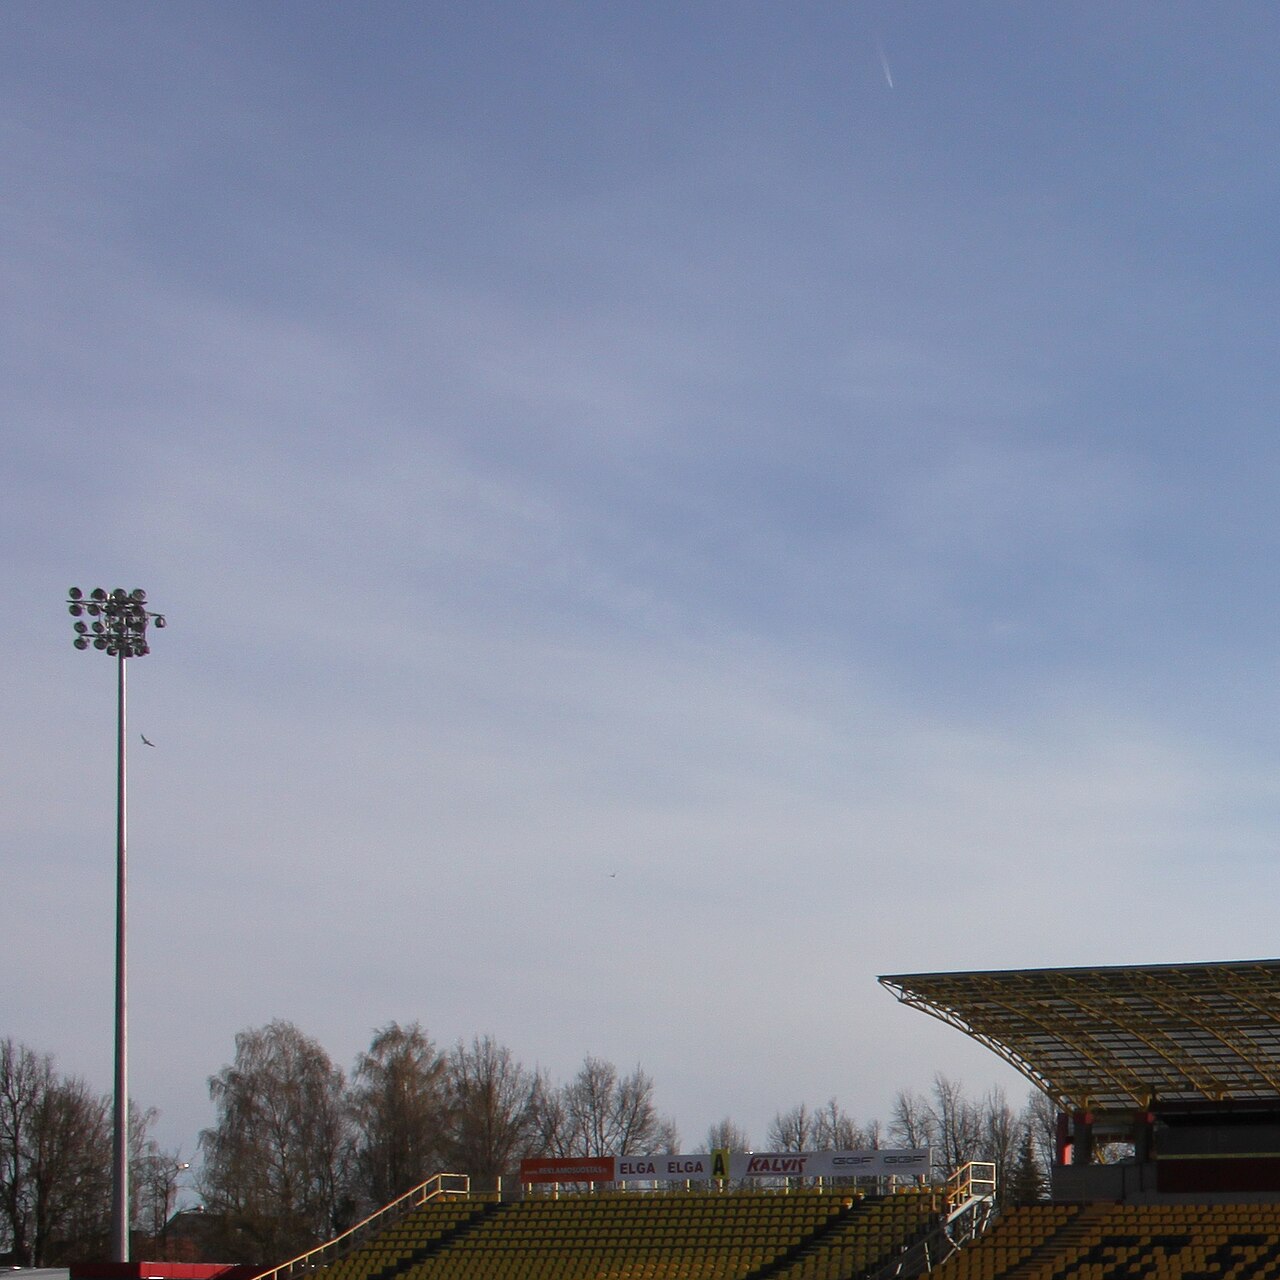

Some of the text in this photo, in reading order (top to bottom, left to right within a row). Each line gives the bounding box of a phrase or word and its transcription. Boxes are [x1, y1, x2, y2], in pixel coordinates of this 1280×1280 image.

[620, 1162, 656, 1174] ELGA
[668, 1161, 704, 1173] ELGA
[713, 1153, 725, 1176] A
